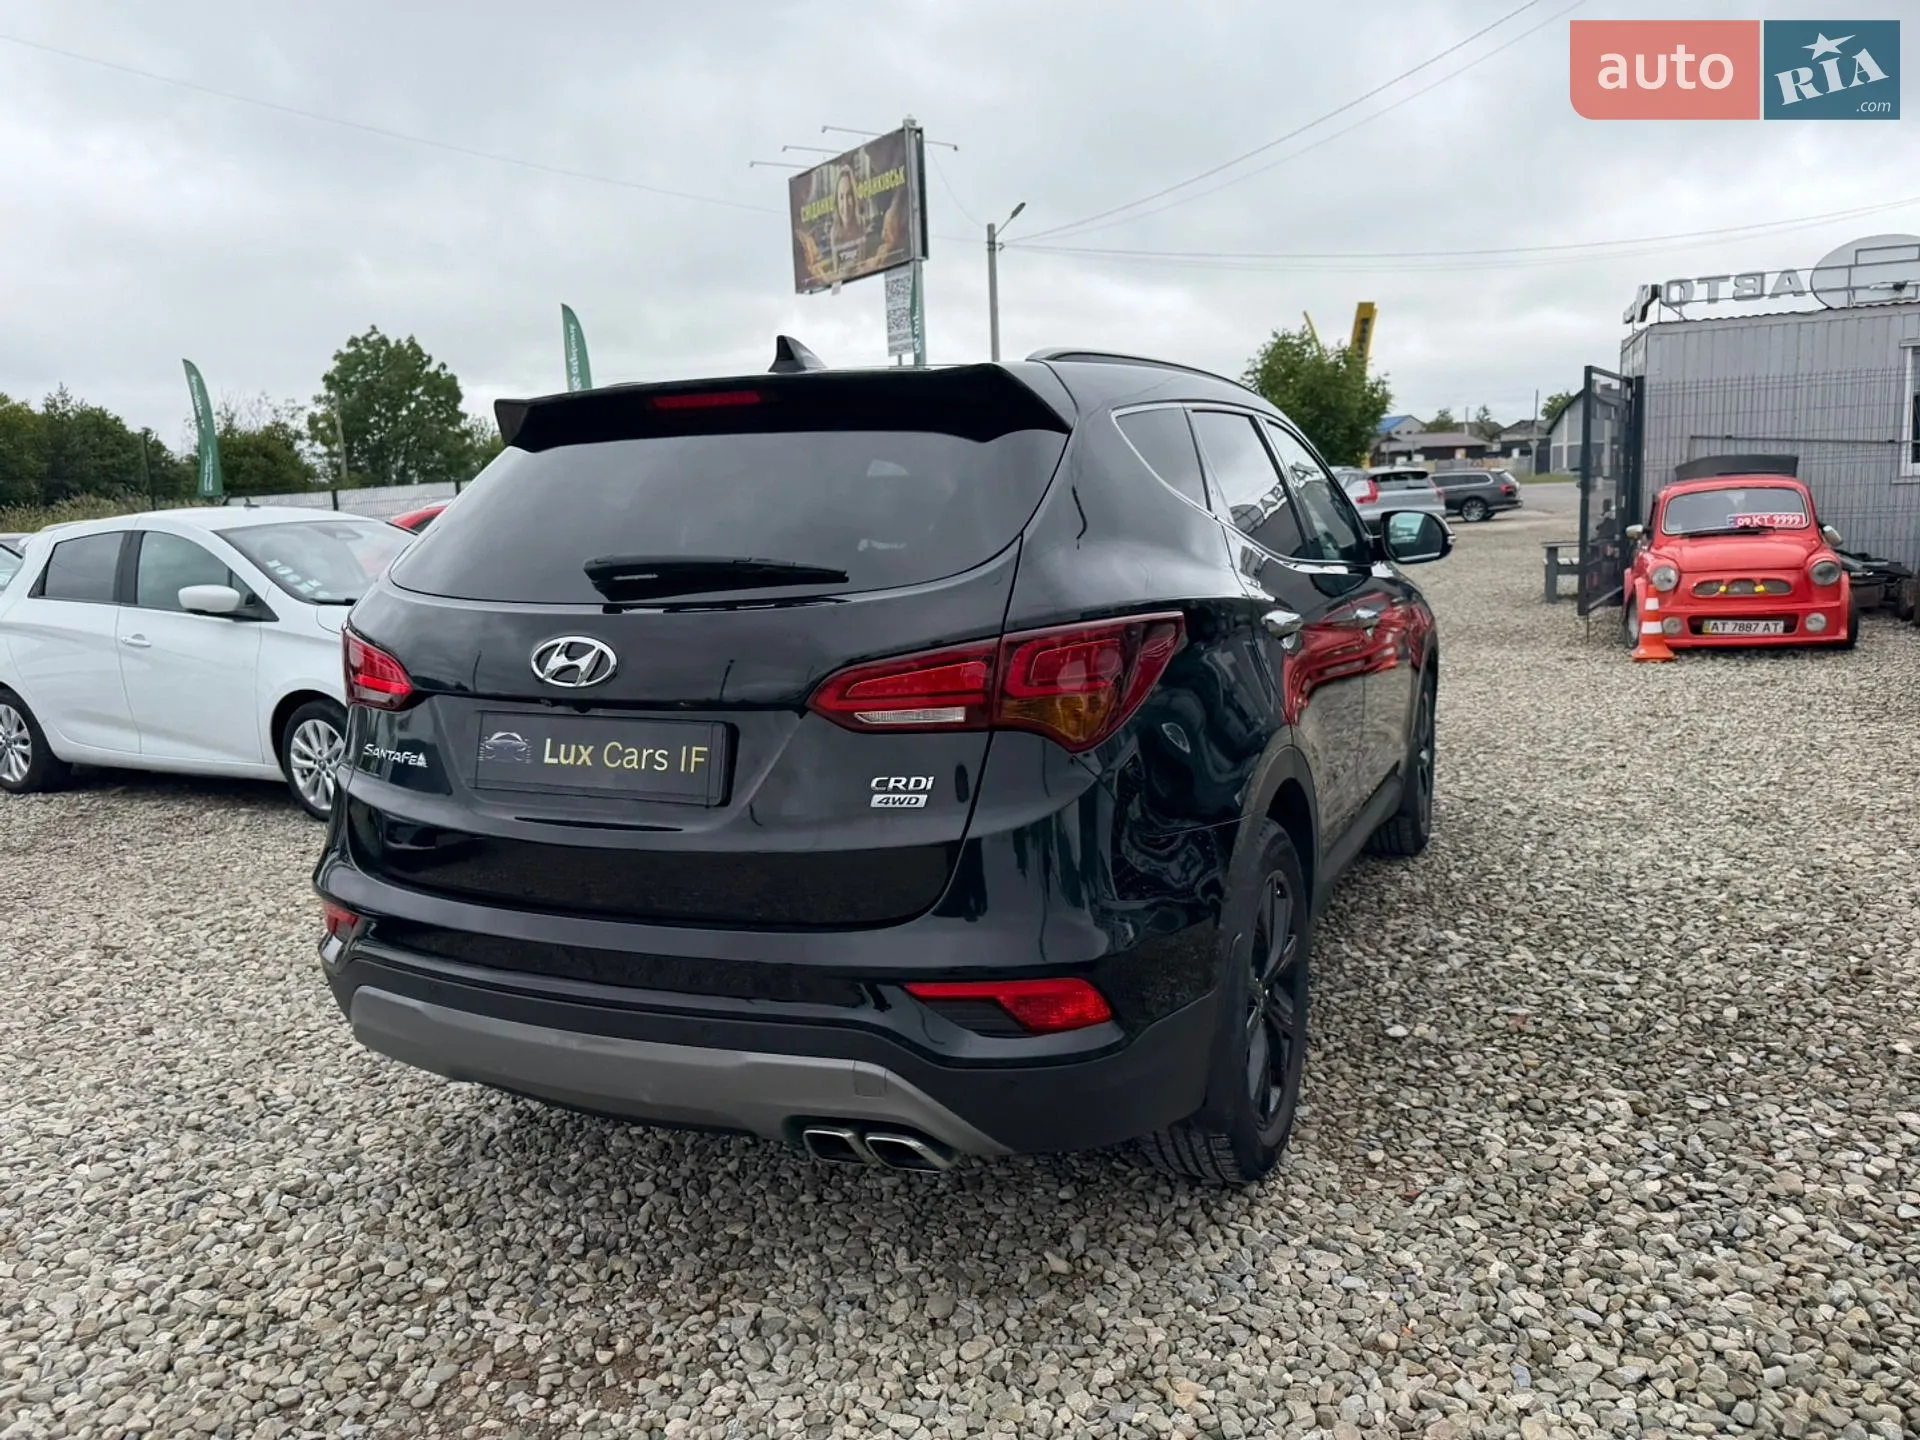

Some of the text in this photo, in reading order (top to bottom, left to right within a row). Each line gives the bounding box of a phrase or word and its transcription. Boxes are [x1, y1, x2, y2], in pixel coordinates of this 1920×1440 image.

[1711, 621, 1781, 632] AT 7887 AT
[543, 737, 708, 773] Lux Cars IF
[876, 796, 920, 806] 4WD
